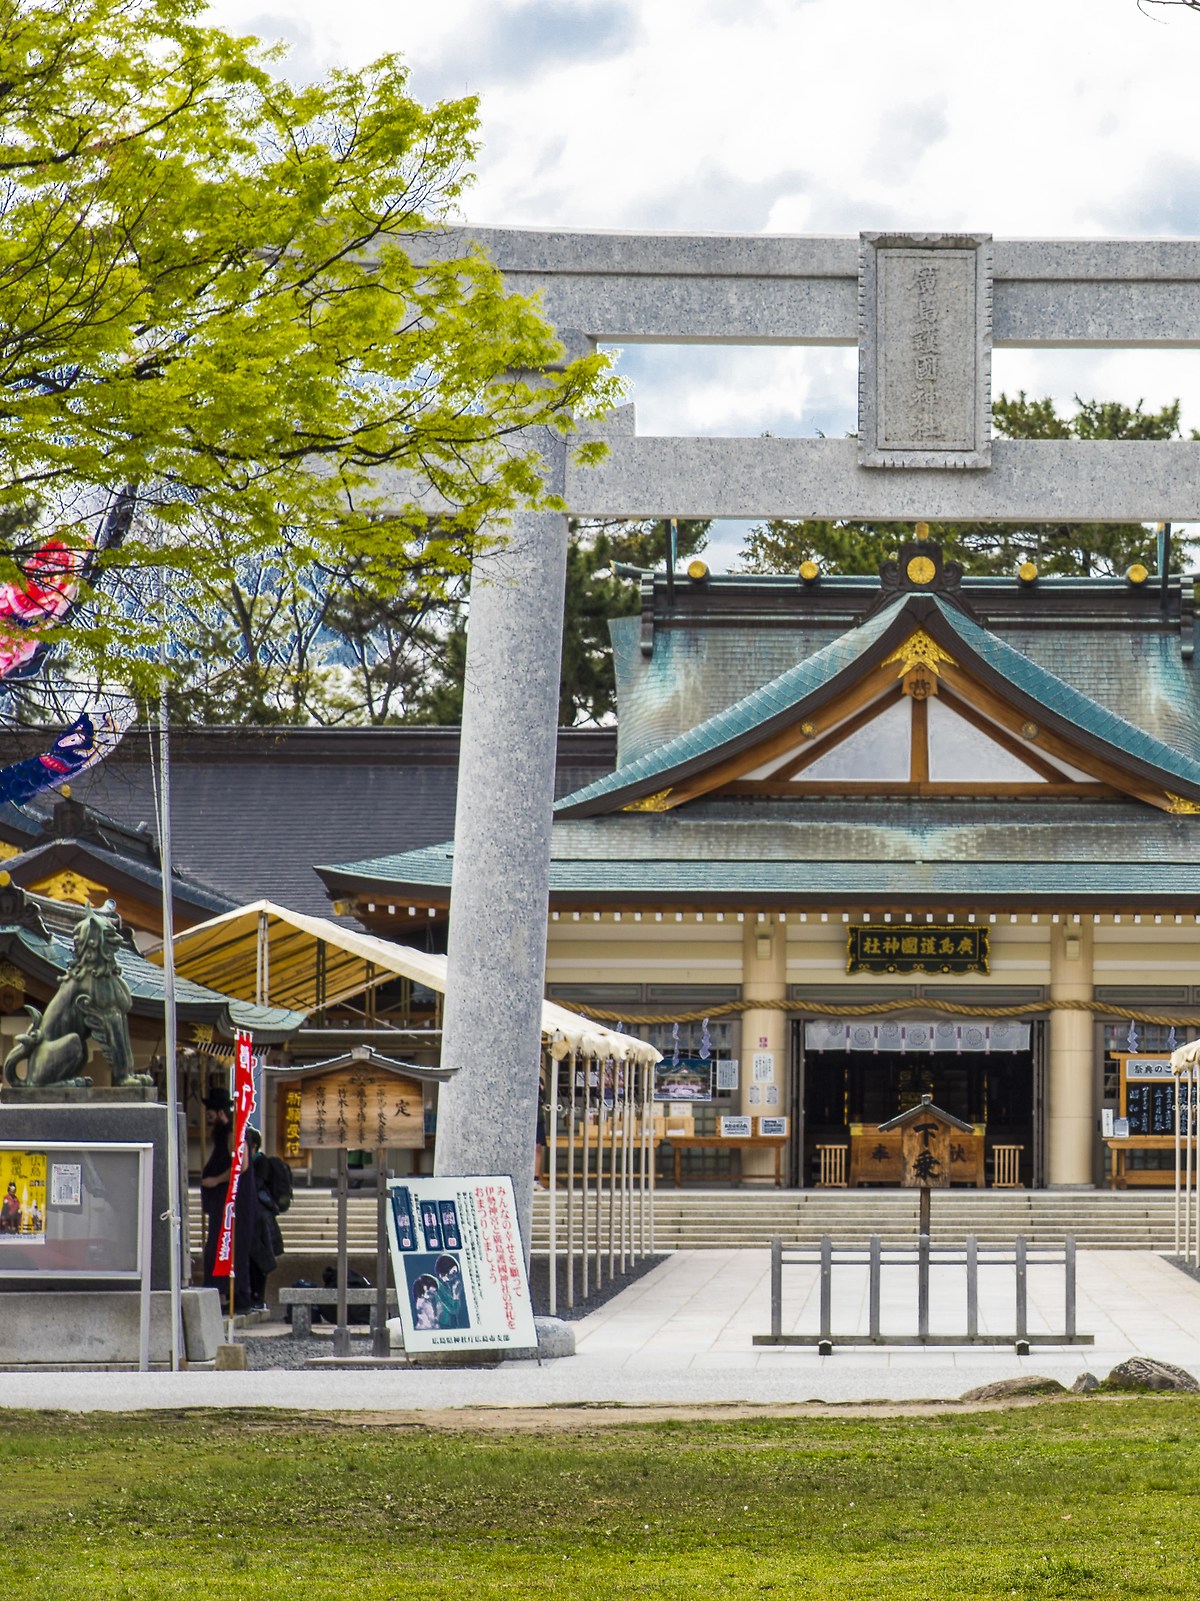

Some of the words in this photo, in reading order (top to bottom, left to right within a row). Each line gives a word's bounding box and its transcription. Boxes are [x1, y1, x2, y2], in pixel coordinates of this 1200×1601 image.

[395, 1099, 411, 1117] 定
[475, 1186, 496, 1284] おまつりしましょう
[497, 1186, 522, 1298] みんなの幸せを願って
